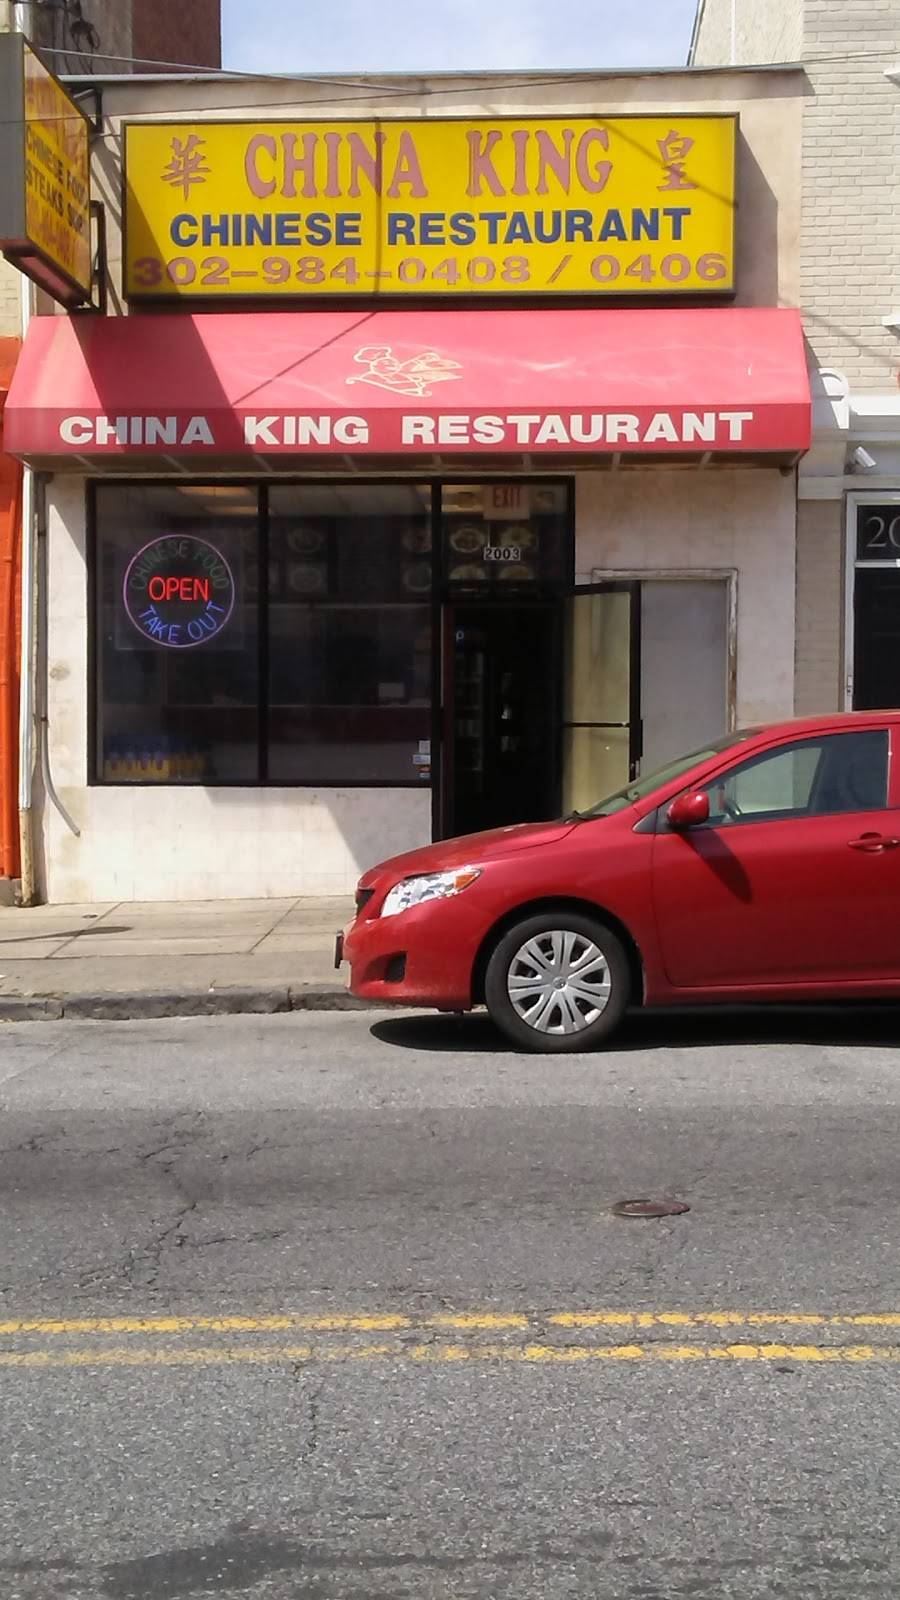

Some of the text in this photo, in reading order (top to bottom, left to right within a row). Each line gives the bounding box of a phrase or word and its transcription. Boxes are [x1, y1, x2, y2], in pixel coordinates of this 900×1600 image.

[160, 134, 211, 202] 華
[244, 128, 613, 199] CHINA KING
[656, 129, 700, 192] 皇
[170, 207, 691, 247] CHINESE RESTAURANT
[132, 254, 531, 287] 302-984-0408
[590, 253, 728, 284] 0406
[59, 412, 753, 445] CHINA KING RESTAURANT
[493, 486, 520, 508] EXIT
[129, 539, 230, 590] CHINESE FOOD
[485, 548, 520, 560] 2003
[148, 576, 210, 602] OPEN
[138, 600, 225, 644] TAKE OUT
